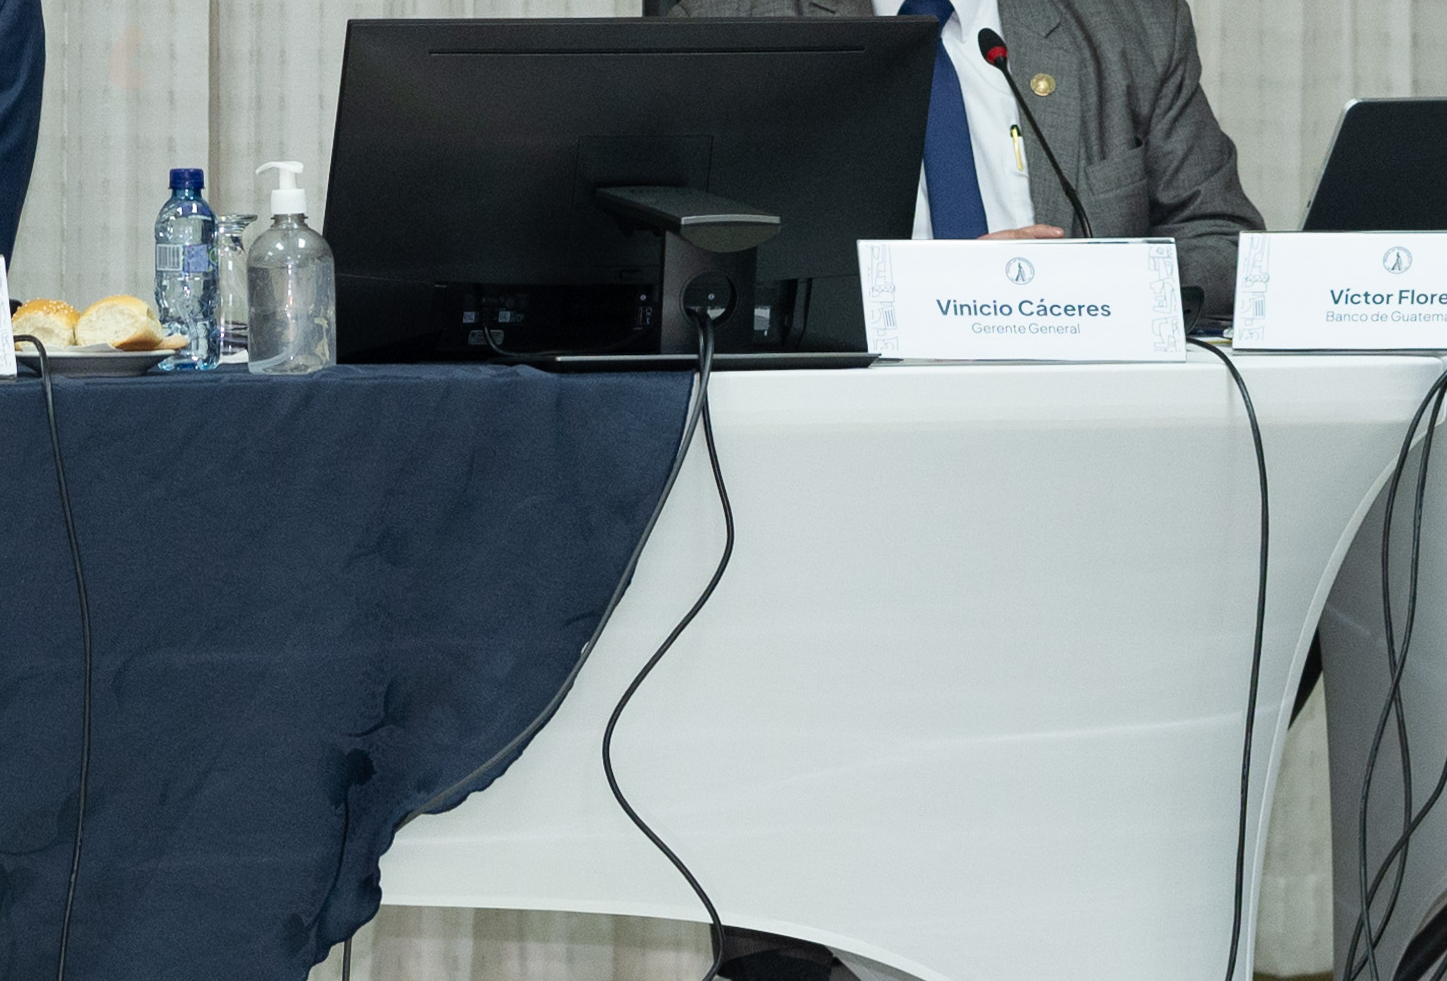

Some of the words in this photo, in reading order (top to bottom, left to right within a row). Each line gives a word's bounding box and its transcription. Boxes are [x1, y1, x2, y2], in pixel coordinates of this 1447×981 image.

[1330, 287, 1394, 305] Víctor
[935, 299, 1013, 317] Vinicio
[1017, 298, 1112, 317] Cáceres
[1325, 310, 1369, 323] Banco
[1370, 311, 1388, 323] de
[971, 322, 1026, 335] Gerente
[1028, 322, 1082, 335] General
